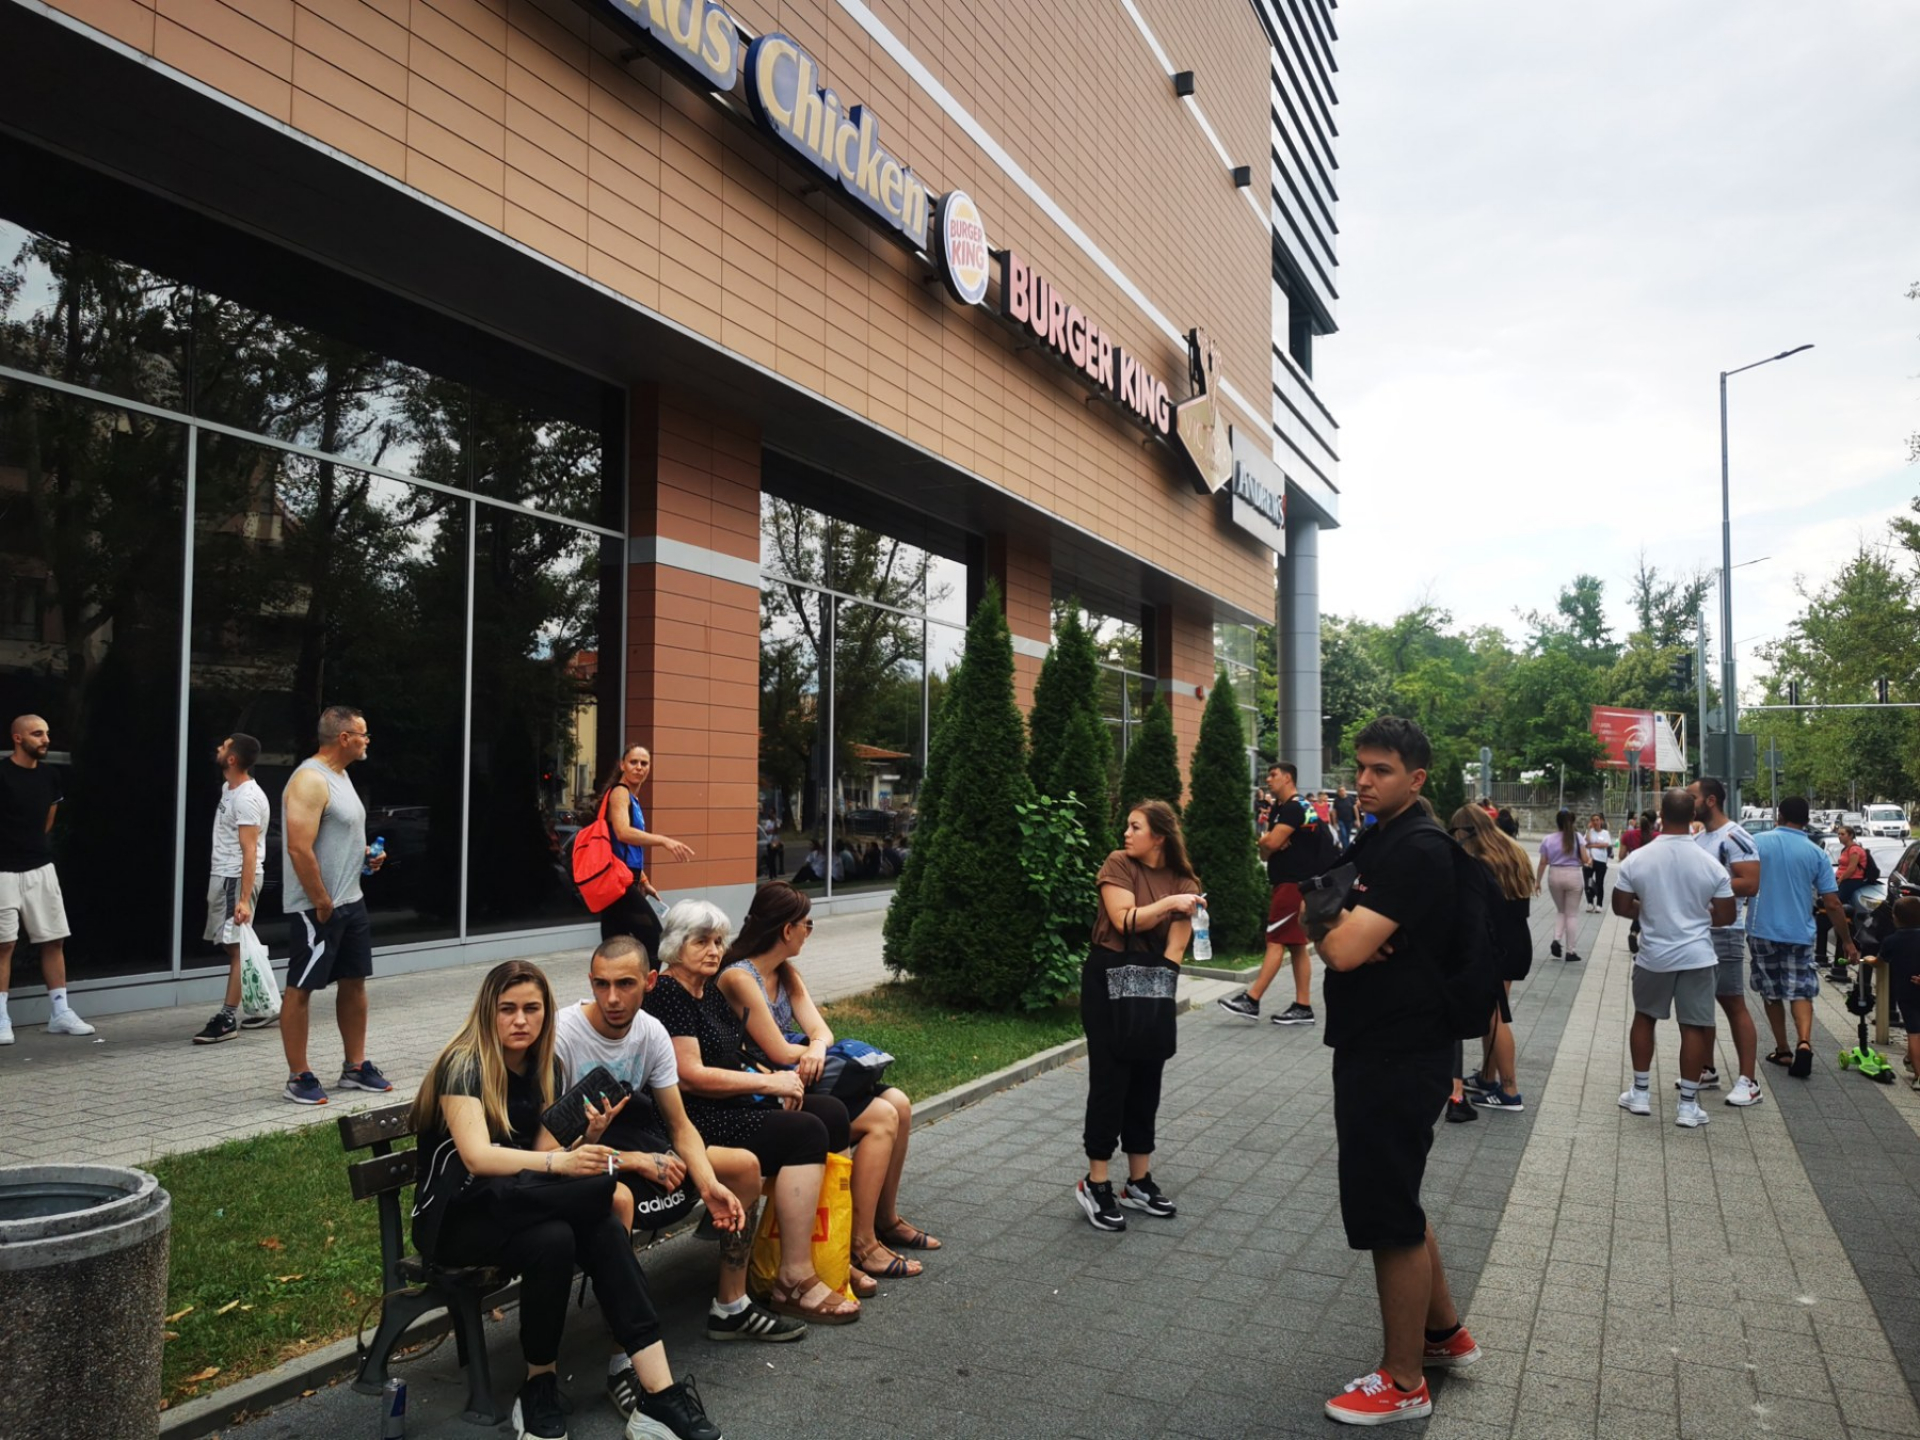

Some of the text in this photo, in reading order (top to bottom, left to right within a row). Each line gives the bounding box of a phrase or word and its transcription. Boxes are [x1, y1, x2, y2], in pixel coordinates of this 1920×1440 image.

[756, 38, 927, 235] Chicken
[950, 219, 983, 243] BURGER
[951, 240, 985, 270] KING
[1009, 252, 1169, 434] BURGER KING
[637, 1189, 686, 1214] adidas
